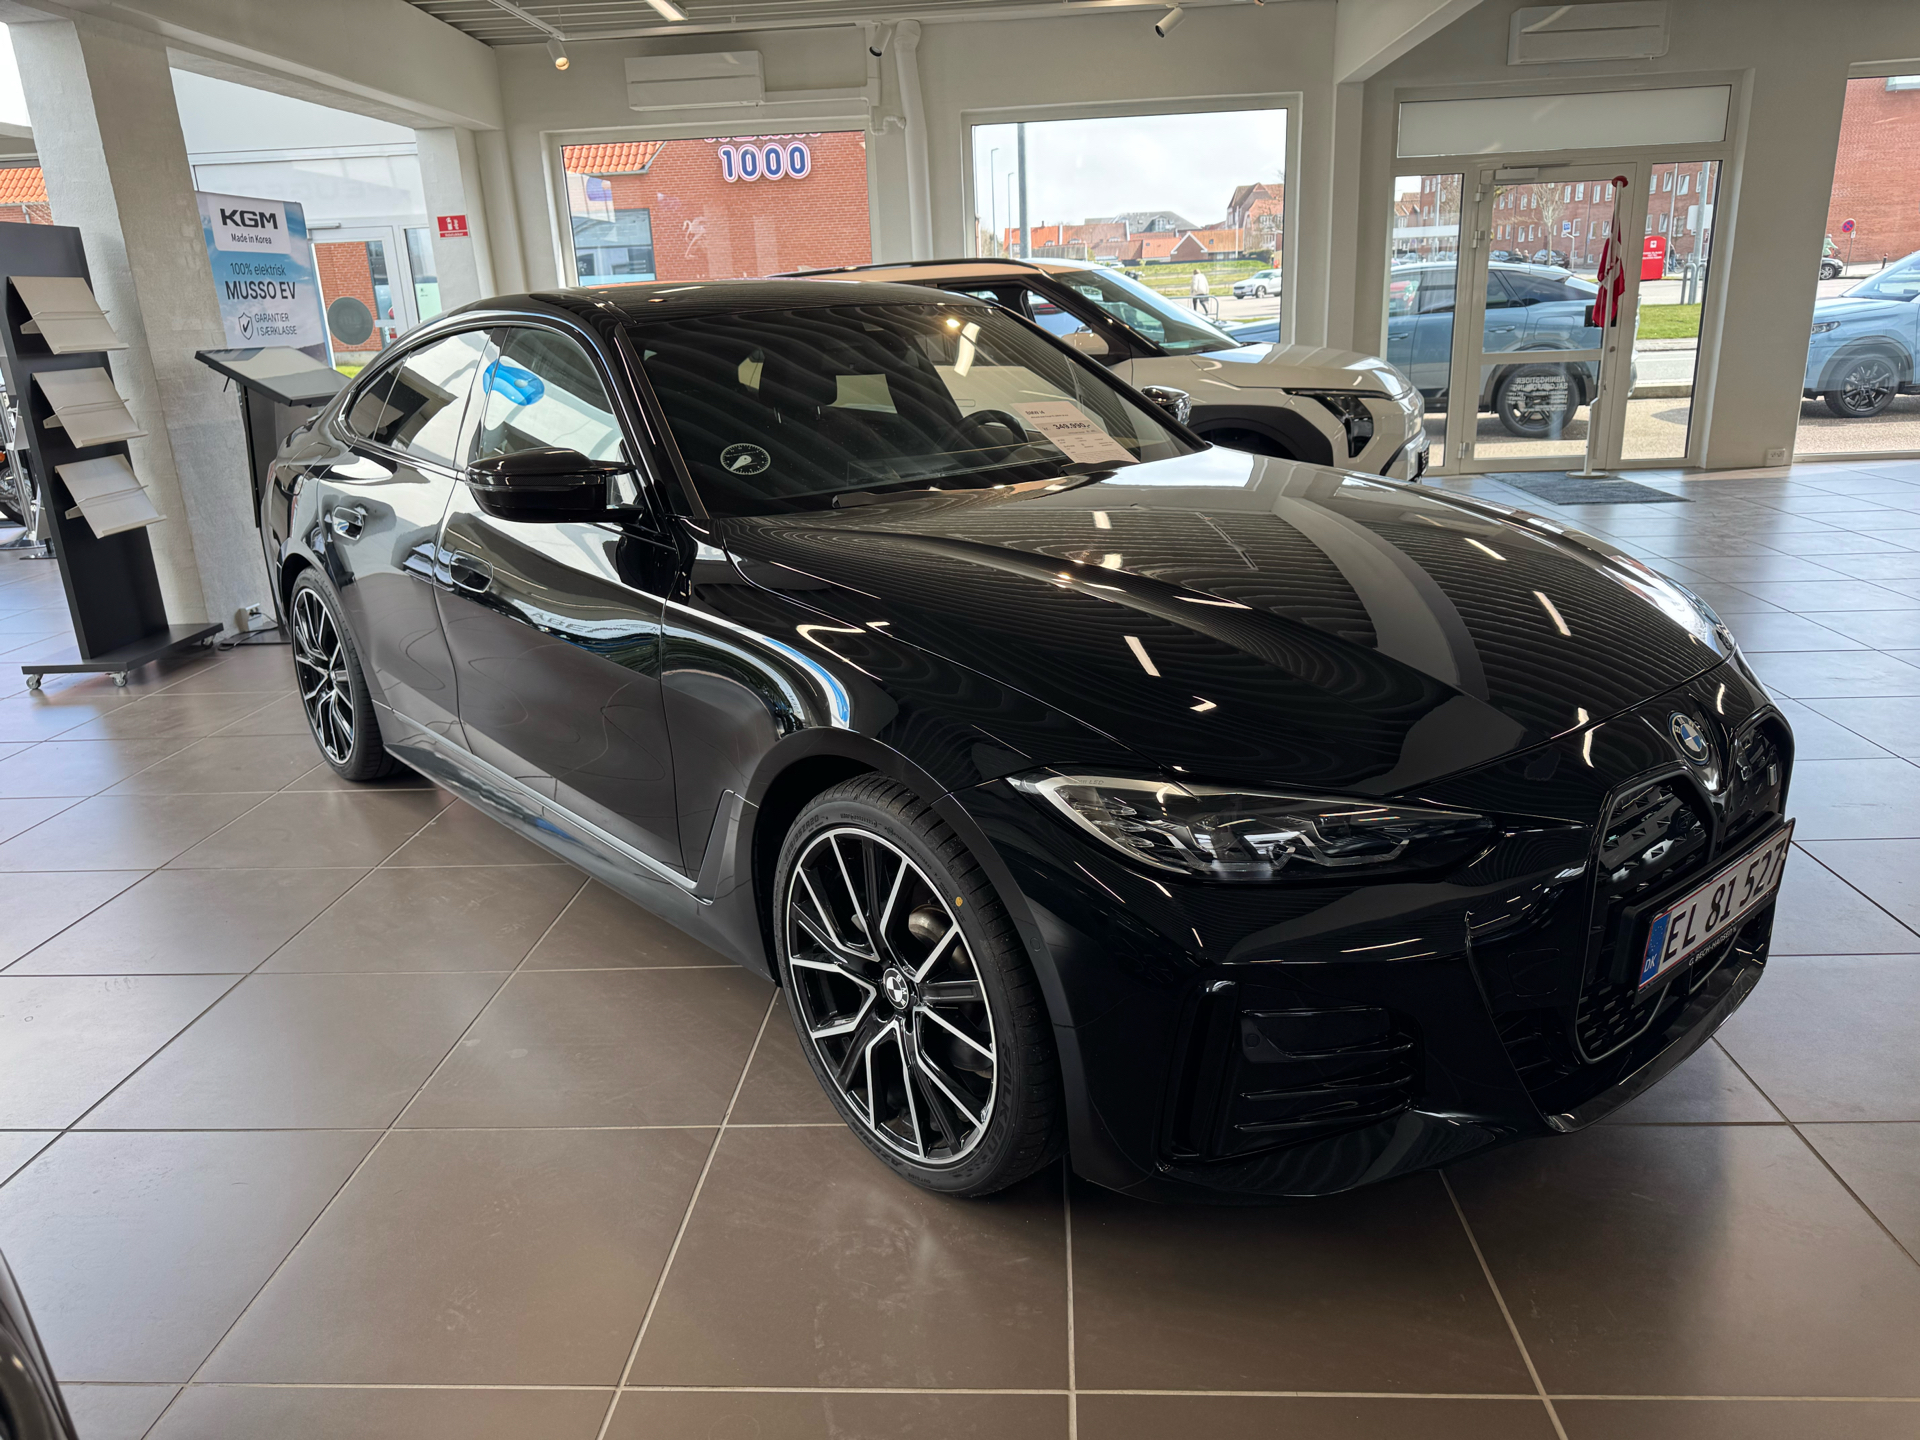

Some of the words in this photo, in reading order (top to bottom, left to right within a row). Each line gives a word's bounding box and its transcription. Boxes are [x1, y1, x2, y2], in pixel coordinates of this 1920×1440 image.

[718, 141, 811, 183] 1000
[220, 208, 278, 229] KGM
[231, 233, 247, 243] Made
[248, 234, 254, 243] in
[255, 234, 272, 244] Korea
[230, 262, 252, 276] 100%
[254, 263, 286, 277] elektrisk
[225, 281, 277, 300] MUSSO
[279, 281, 296, 300] EV
[254, 313, 290, 323] GARANTIER
[261, 325, 297, 336] SÆRKLASSE
[1662, 902, 1697, 963] EL
[1705, 874, 1737, 933] 81
[1739, 838, 1786, 908] 527
[1643, 954, 1657, 973] DK
